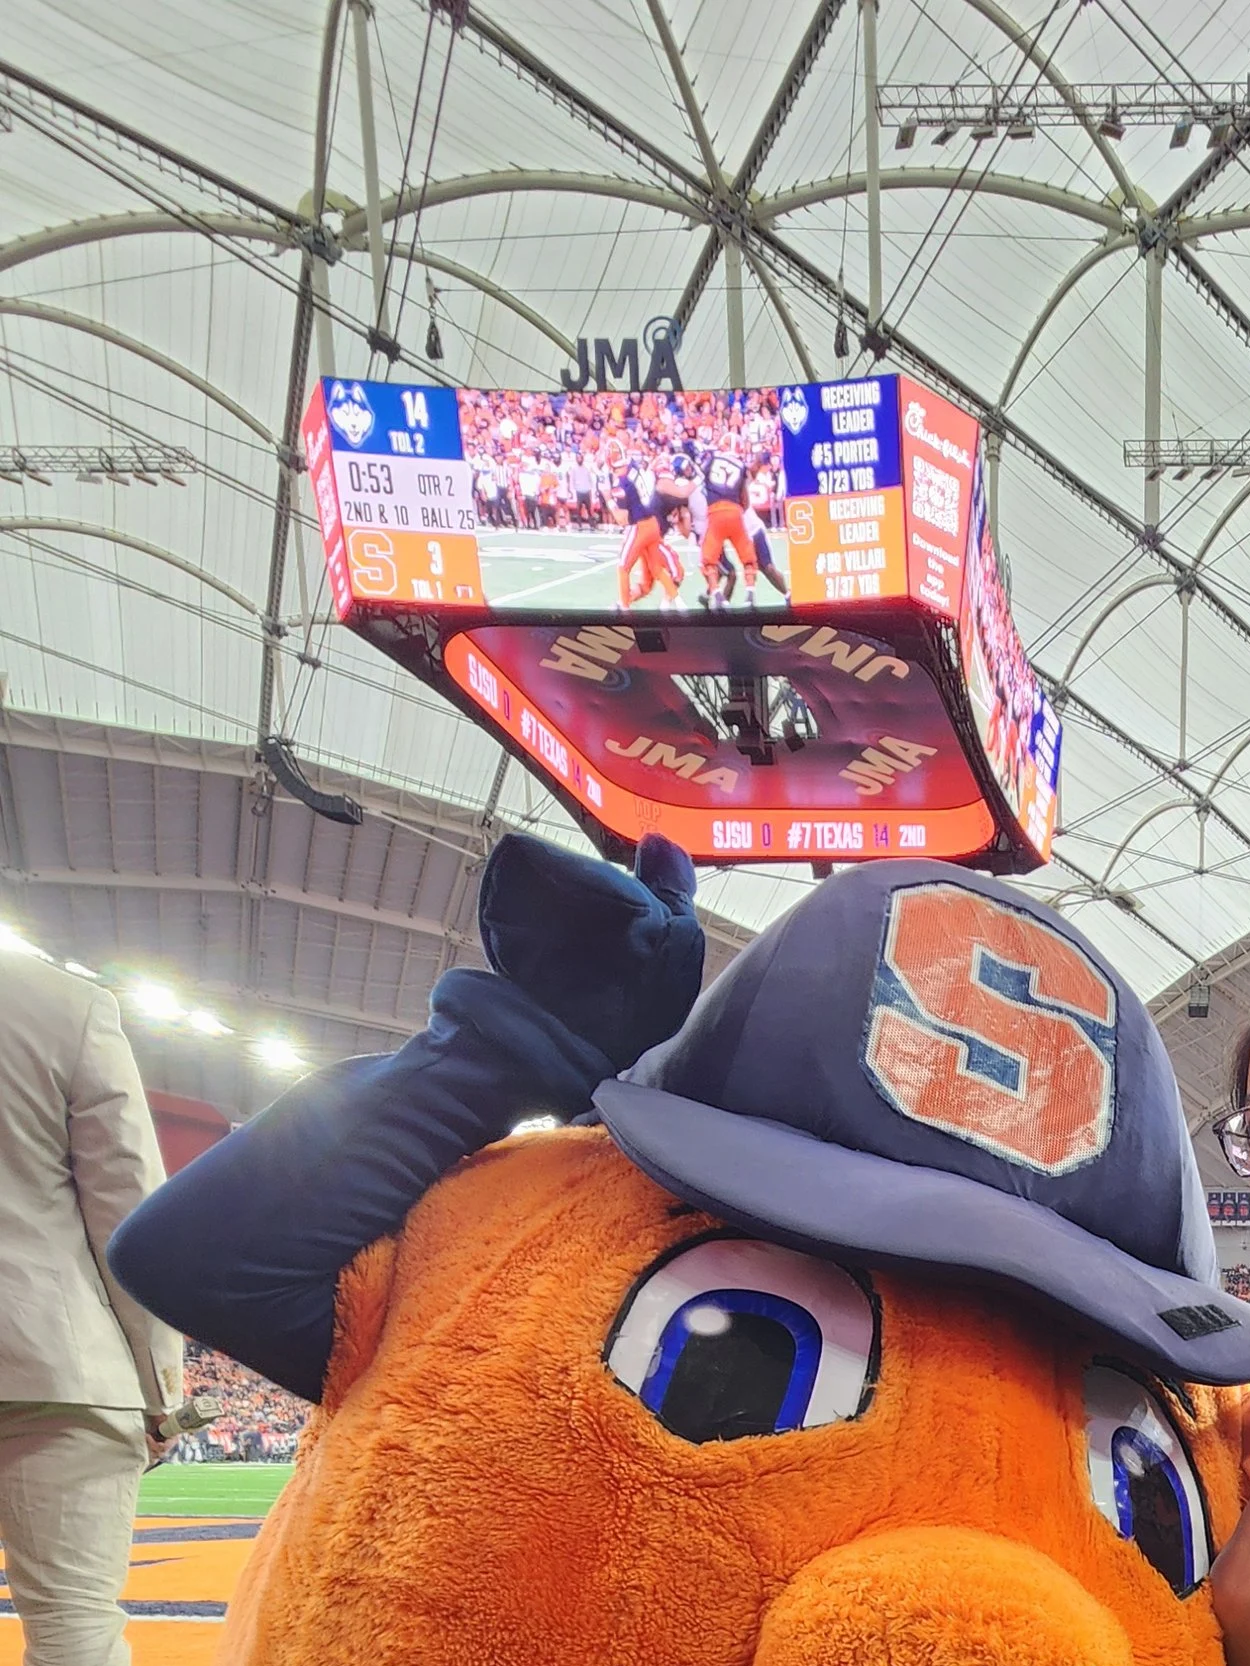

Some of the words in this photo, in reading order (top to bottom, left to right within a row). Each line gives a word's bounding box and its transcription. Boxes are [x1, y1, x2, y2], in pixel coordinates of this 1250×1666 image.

[560, 337, 684, 391] JMA
[402, 390, 429, 428] 14
[821, 381, 880, 409] RECEIVING
[832, 408, 875, 434] LEADER
[414, 433, 425, 454] 2
[812, 442, 832, 467] #5
[834, 438, 879, 464] PORTER
[349, 461, 394, 494] 0:53
[418, 474, 441, 497] QTR
[446, 476, 455, 496] 2
[710, 457, 740, 488] 57
[818, 469, 849, 494] 3/23
[851, 467, 875, 491] YDS
[344, 501, 373, 523] 2ND
[379, 504, 388, 524] &
[394, 505, 409, 525] 10
[422, 507, 453, 529] BALL
[458, 510, 475, 530] 25
[829, 495, 885, 520] RECEIVING
[839, 521, 879, 545] LEADER
[350, 529, 397, 595] S
[428, 541, 442, 575] 3
[844, 548, 886, 571] VILLARI
[912, 532, 960, 567] Download
[927, 556, 944, 575] the
[435, 581, 443, 599] 1
[825, 575, 854, 599] 3/37
[858, 573, 880, 596] YDS
[539, 626, 636, 682] MA
[468, 653, 498, 709] SJSU
[503, 690, 511, 721] 0
[521, 708, 537, 746] #7
[537, 720, 568, 778] TEXAS
[604, 736, 740, 794] JMA
[839, 736, 938, 796] JMA
[713, 820, 752, 849] SJSU
[762, 822, 771, 847] 0
[787, 822, 812, 849] #7
[814, 821, 864, 849] TEXAS
[874, 824, 889, 848] 14
[899, 824, 926, 848] 2ND
[862, 881, 1117, 1178] S
